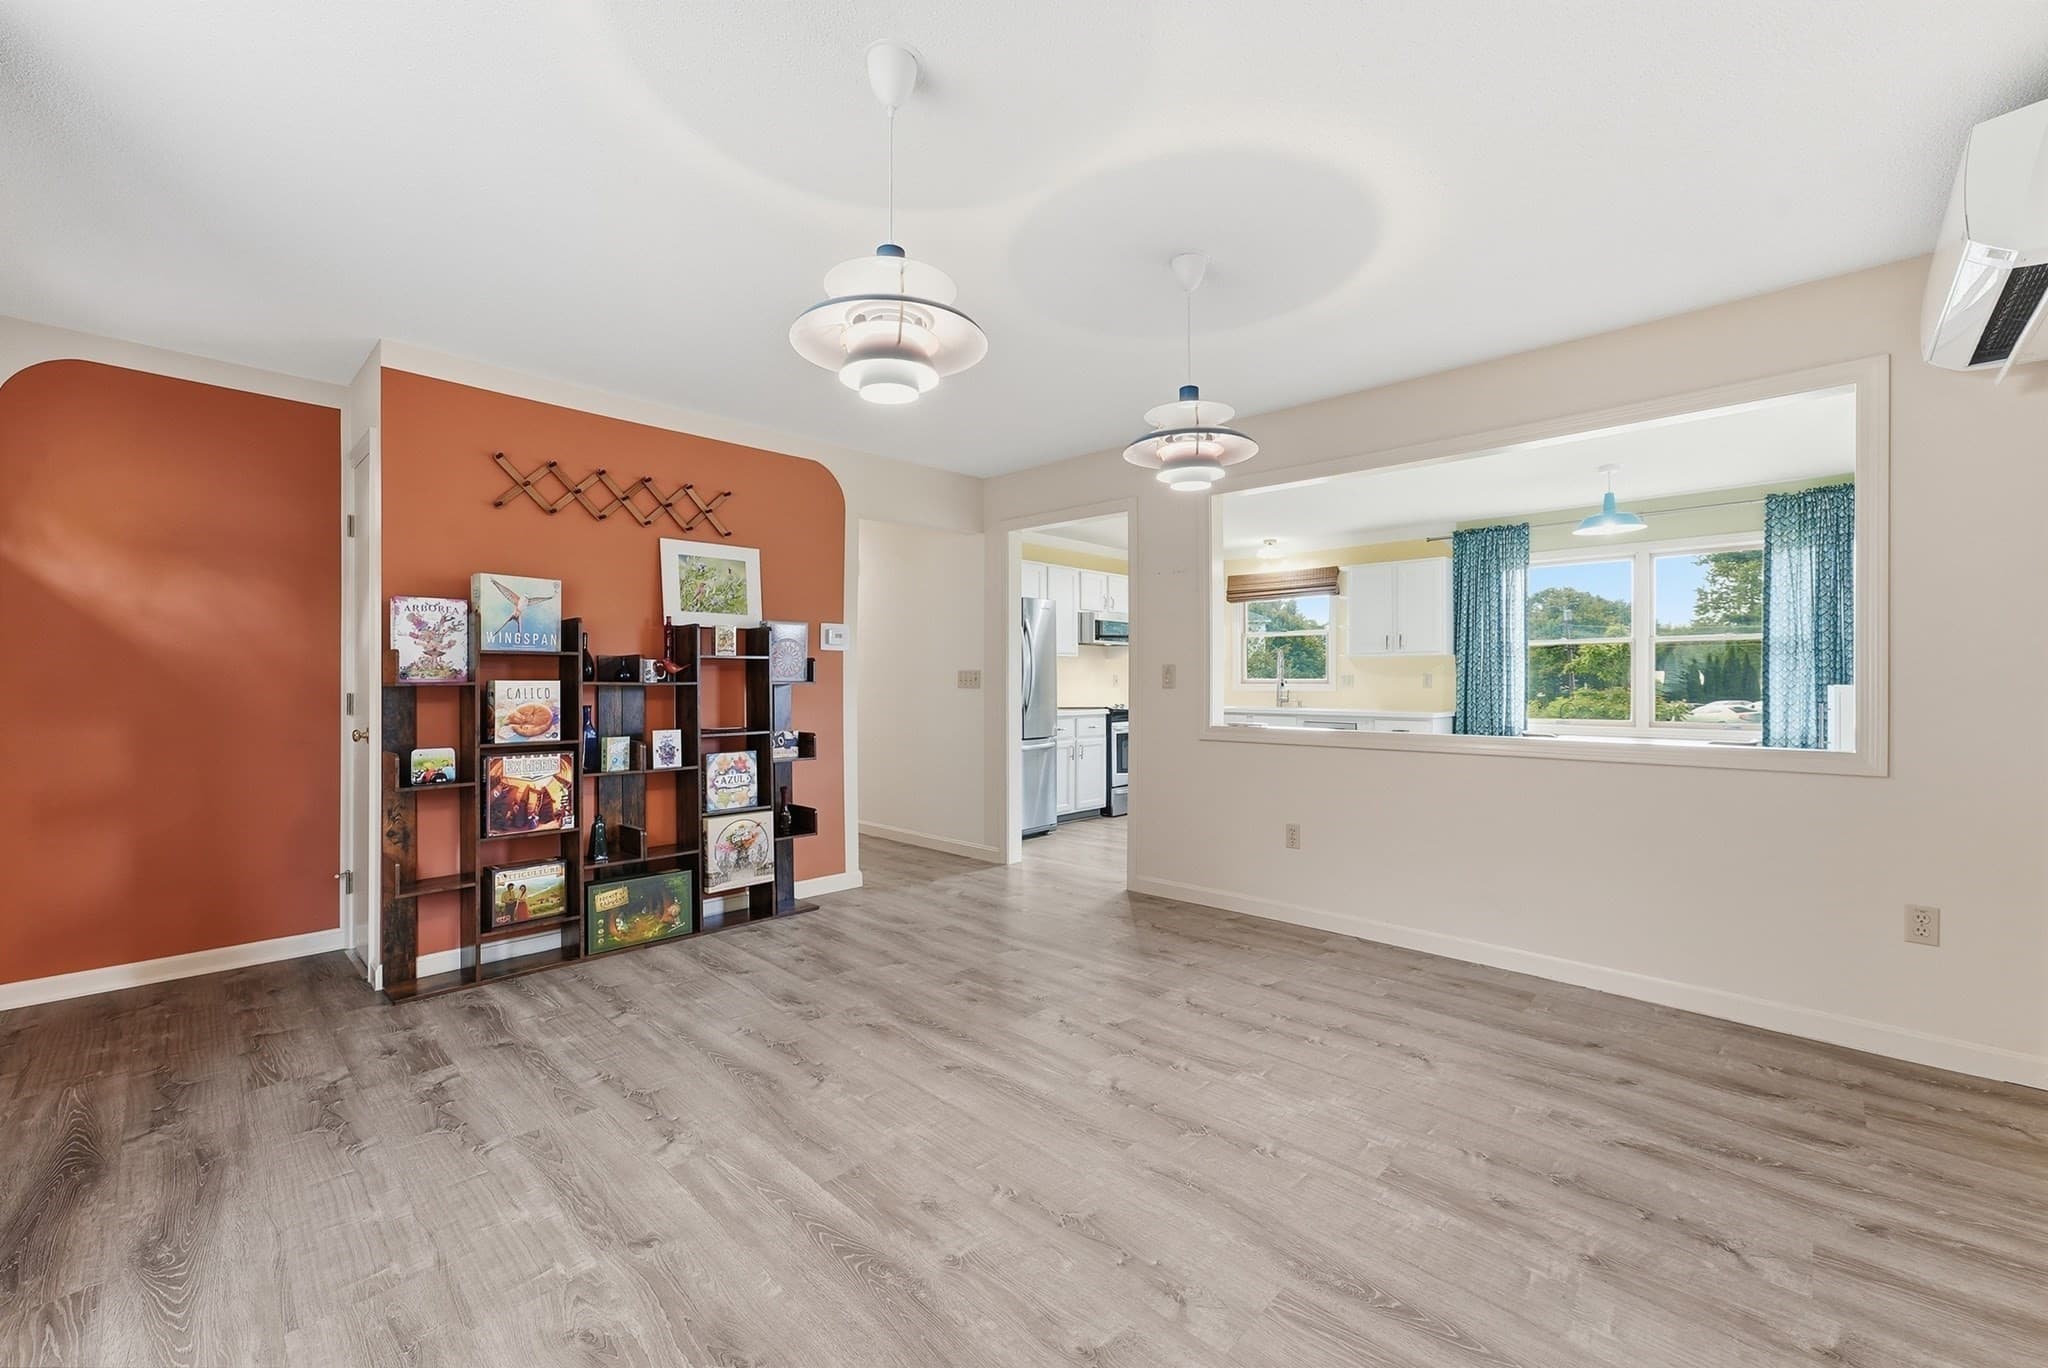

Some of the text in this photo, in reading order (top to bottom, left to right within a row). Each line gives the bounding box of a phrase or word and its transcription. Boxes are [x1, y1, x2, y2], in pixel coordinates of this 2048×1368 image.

[404, 602, 459, 615] ARBOREA
[486, 631, 558, 646] WINGSPAN
[506, 687, 551, 700] CALICO
[720, 774, 745, 785] AZUL
